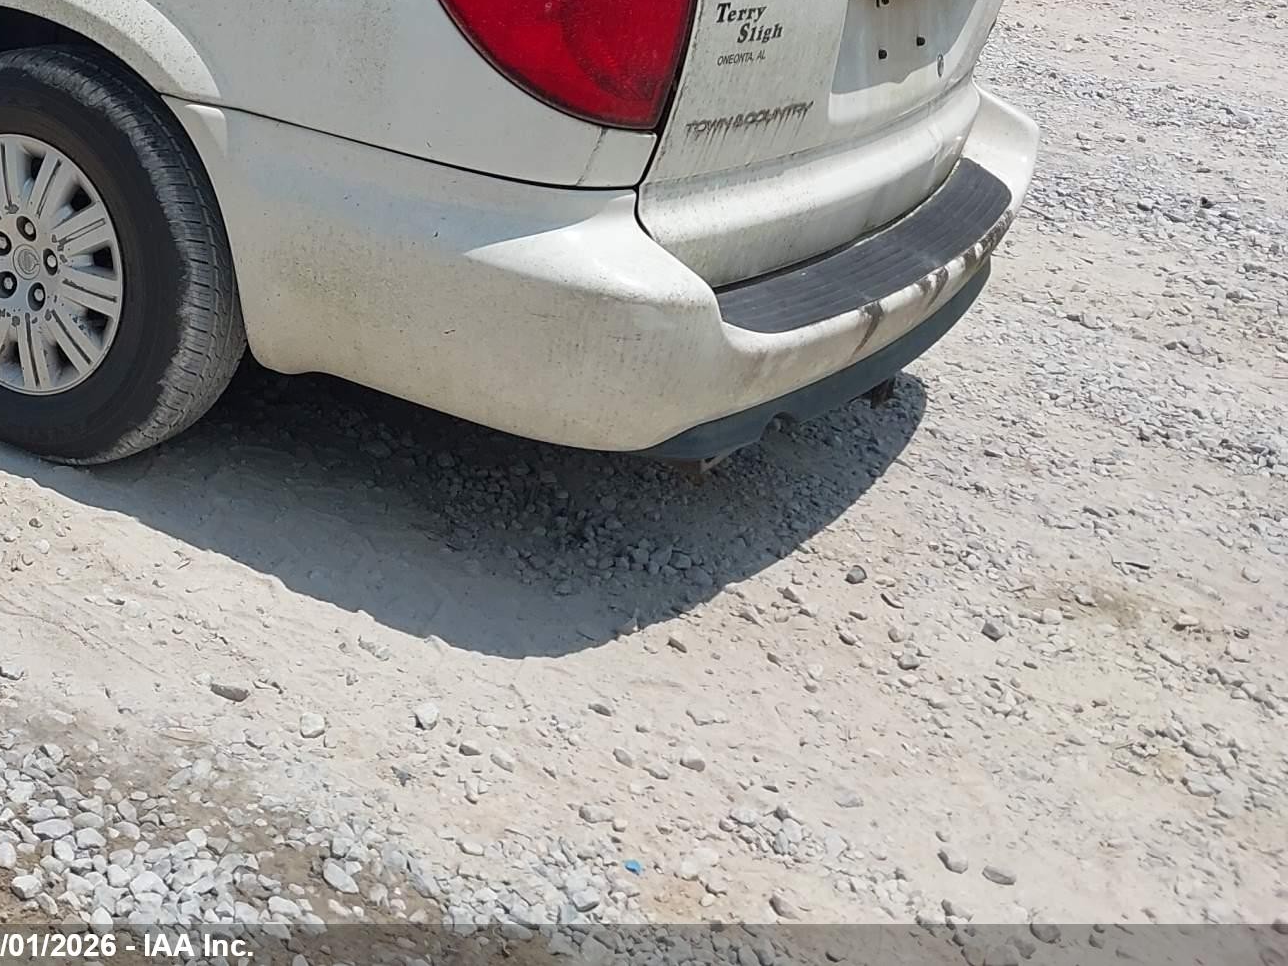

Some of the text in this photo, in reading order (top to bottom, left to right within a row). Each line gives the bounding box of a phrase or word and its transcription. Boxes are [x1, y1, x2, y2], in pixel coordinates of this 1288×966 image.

[716, 2, 767, 23] Terry
[737, 22, 783, 43] Sligh
[756, 49, 766, 60] AL
